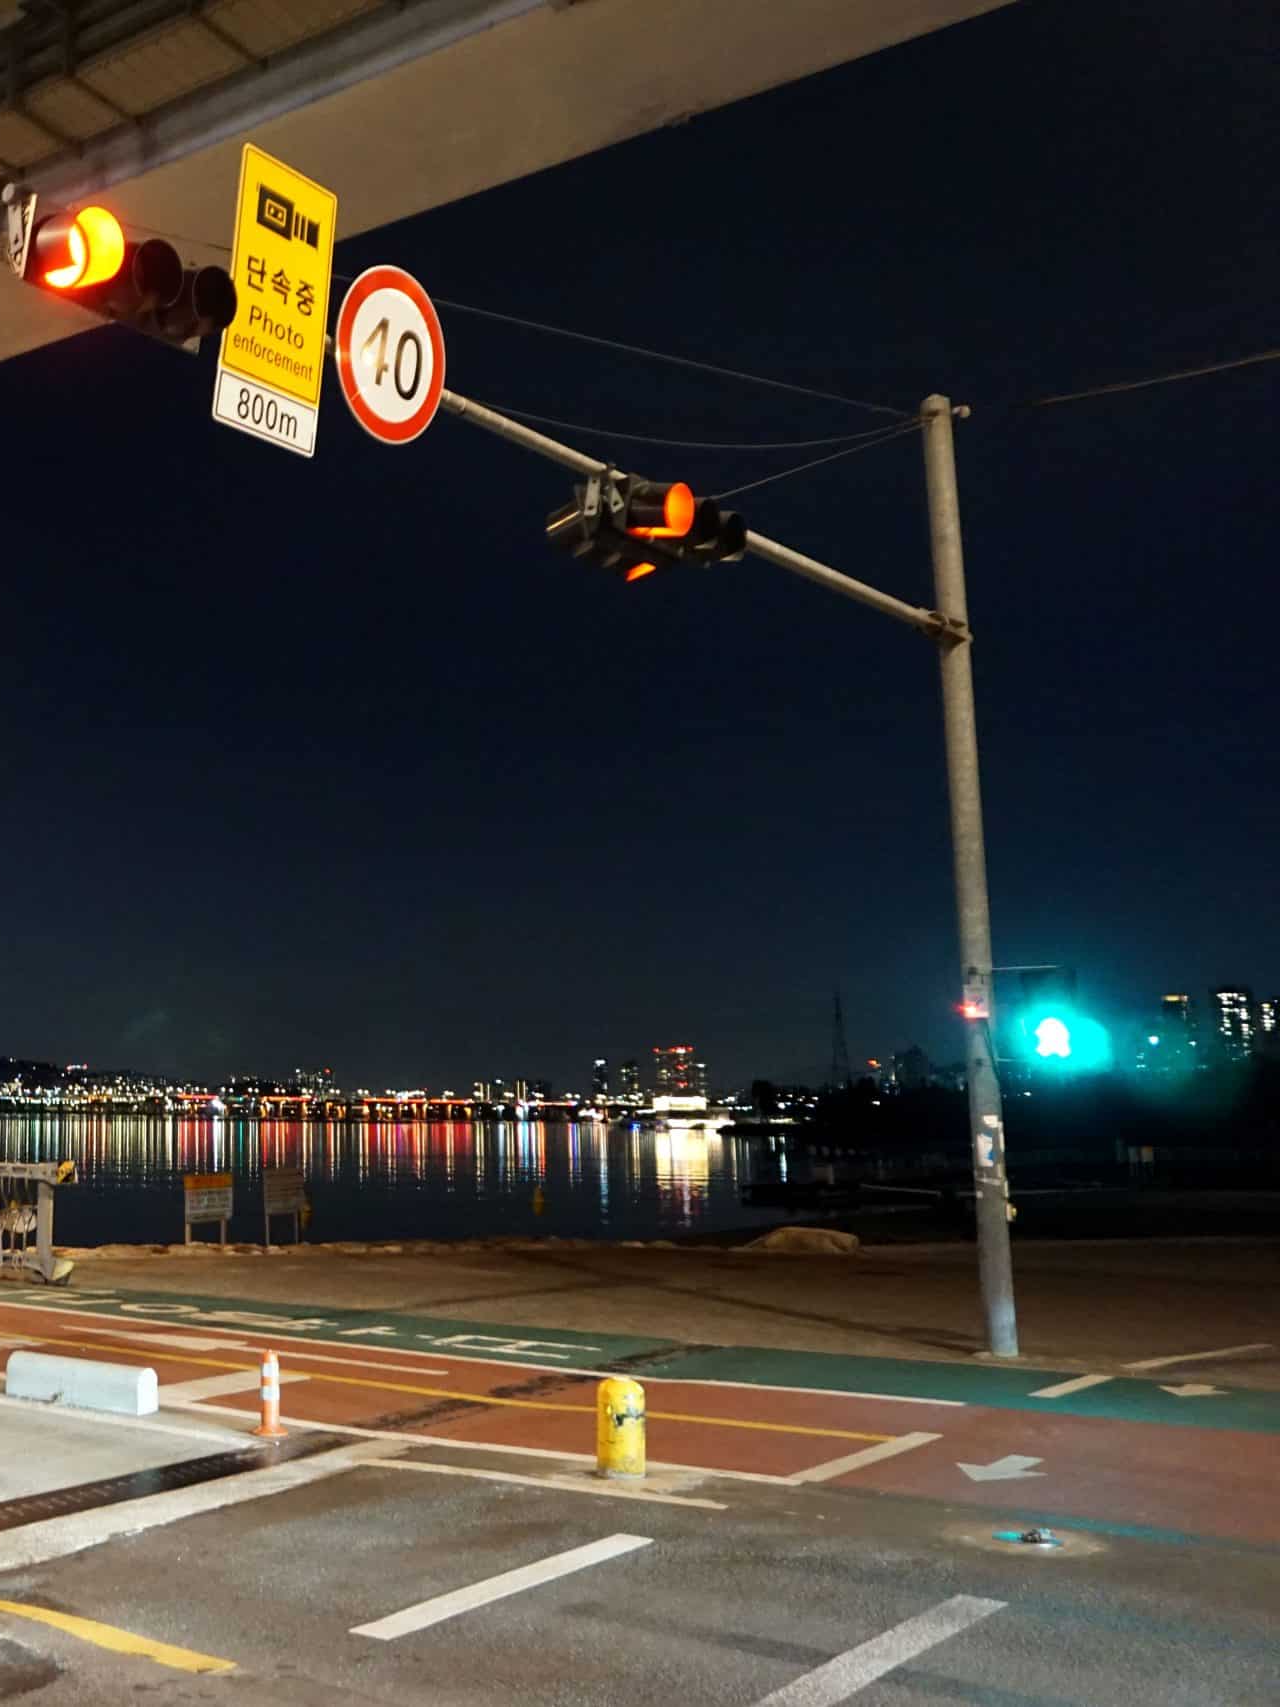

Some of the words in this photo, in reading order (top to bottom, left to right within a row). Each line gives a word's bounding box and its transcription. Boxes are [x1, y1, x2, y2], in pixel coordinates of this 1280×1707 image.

[247, 255, 315, 316] 단속중
[249, 305, 304, 349] Photo
[233, 332, 312, 381] enforcement
[361, 317, 423, 401] 40
[237, 387, 297, 439] 800m
